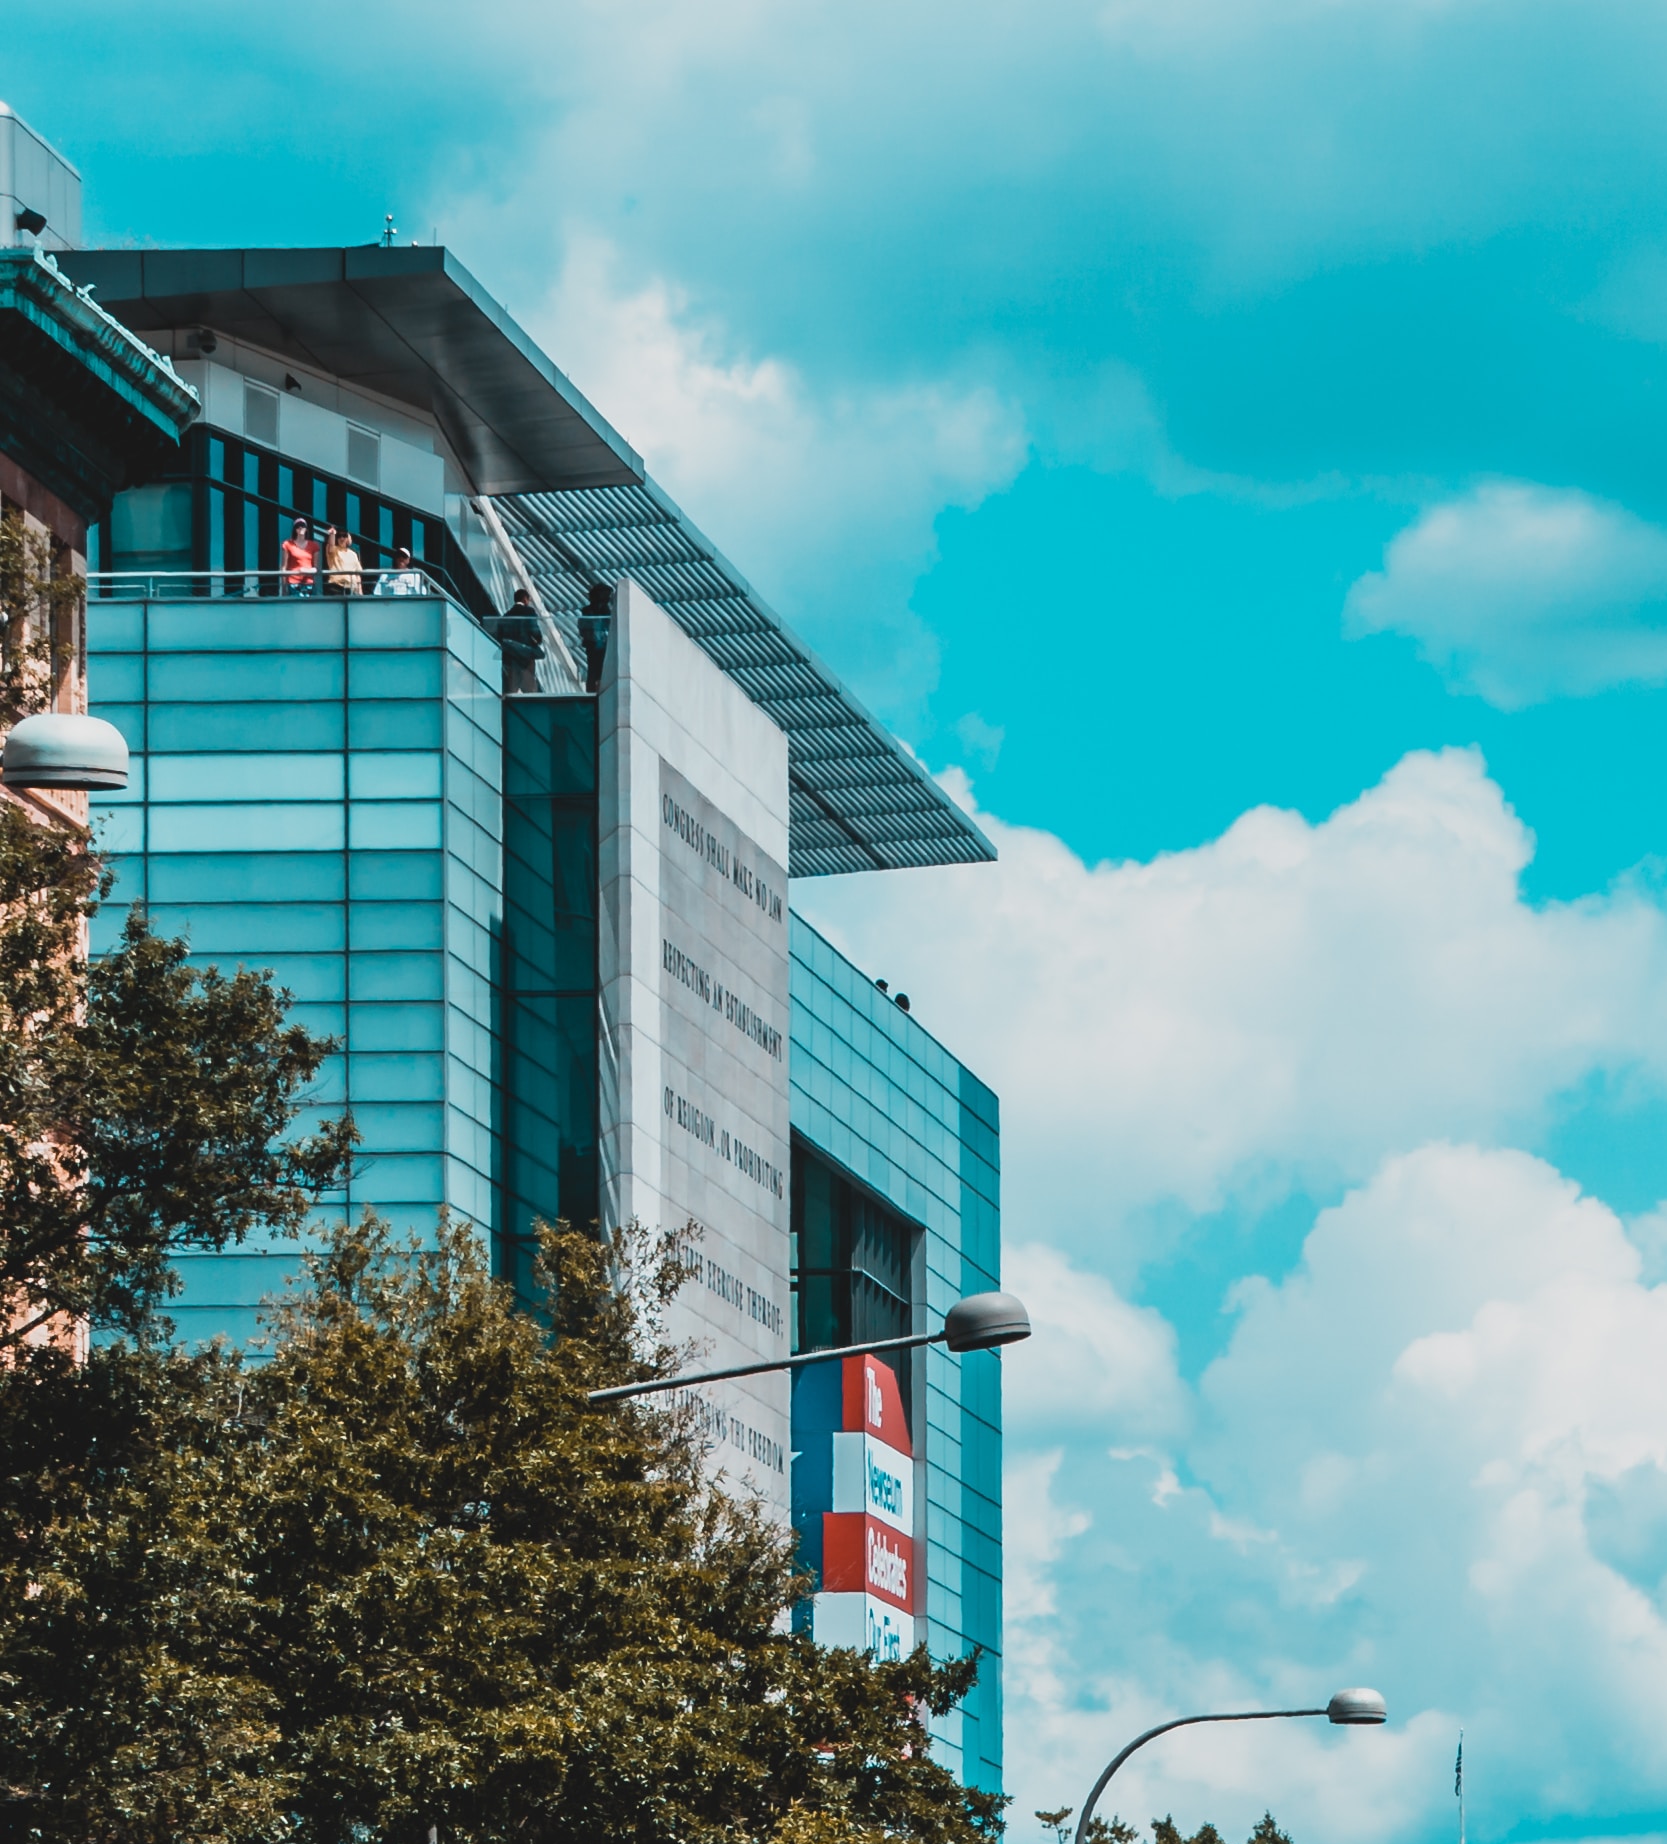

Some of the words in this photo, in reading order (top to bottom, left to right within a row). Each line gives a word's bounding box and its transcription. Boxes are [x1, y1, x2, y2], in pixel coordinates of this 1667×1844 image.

[663, 793, 704, 857] CONGRESS
[706, 833, 730, 879] SHALL
[733, 856, 753, 900] MAKE
[755, 878, 767, 911] NO
[769, 889, 782, 924] LAW
[663, 938, 710, 1004] RESPECTING
[712, 980, 723, 1013] AN
[725, 990, 782, 1063] ESTABLISHMENT
[664, 1086, 674, 1119] OF
[734, 1138, 783, 1201] PROHIBITING
[707, 1260, 743, 1311] EXERCISE
[867, 1366, 883, 1428] The
[730, 1416, 745, 1452] THE
[749, 1427, 784, 1475] FREEDOM
[867, 1447, 903, 1518] Newseum
[867, 1527, 907, 1600] Celebrates
